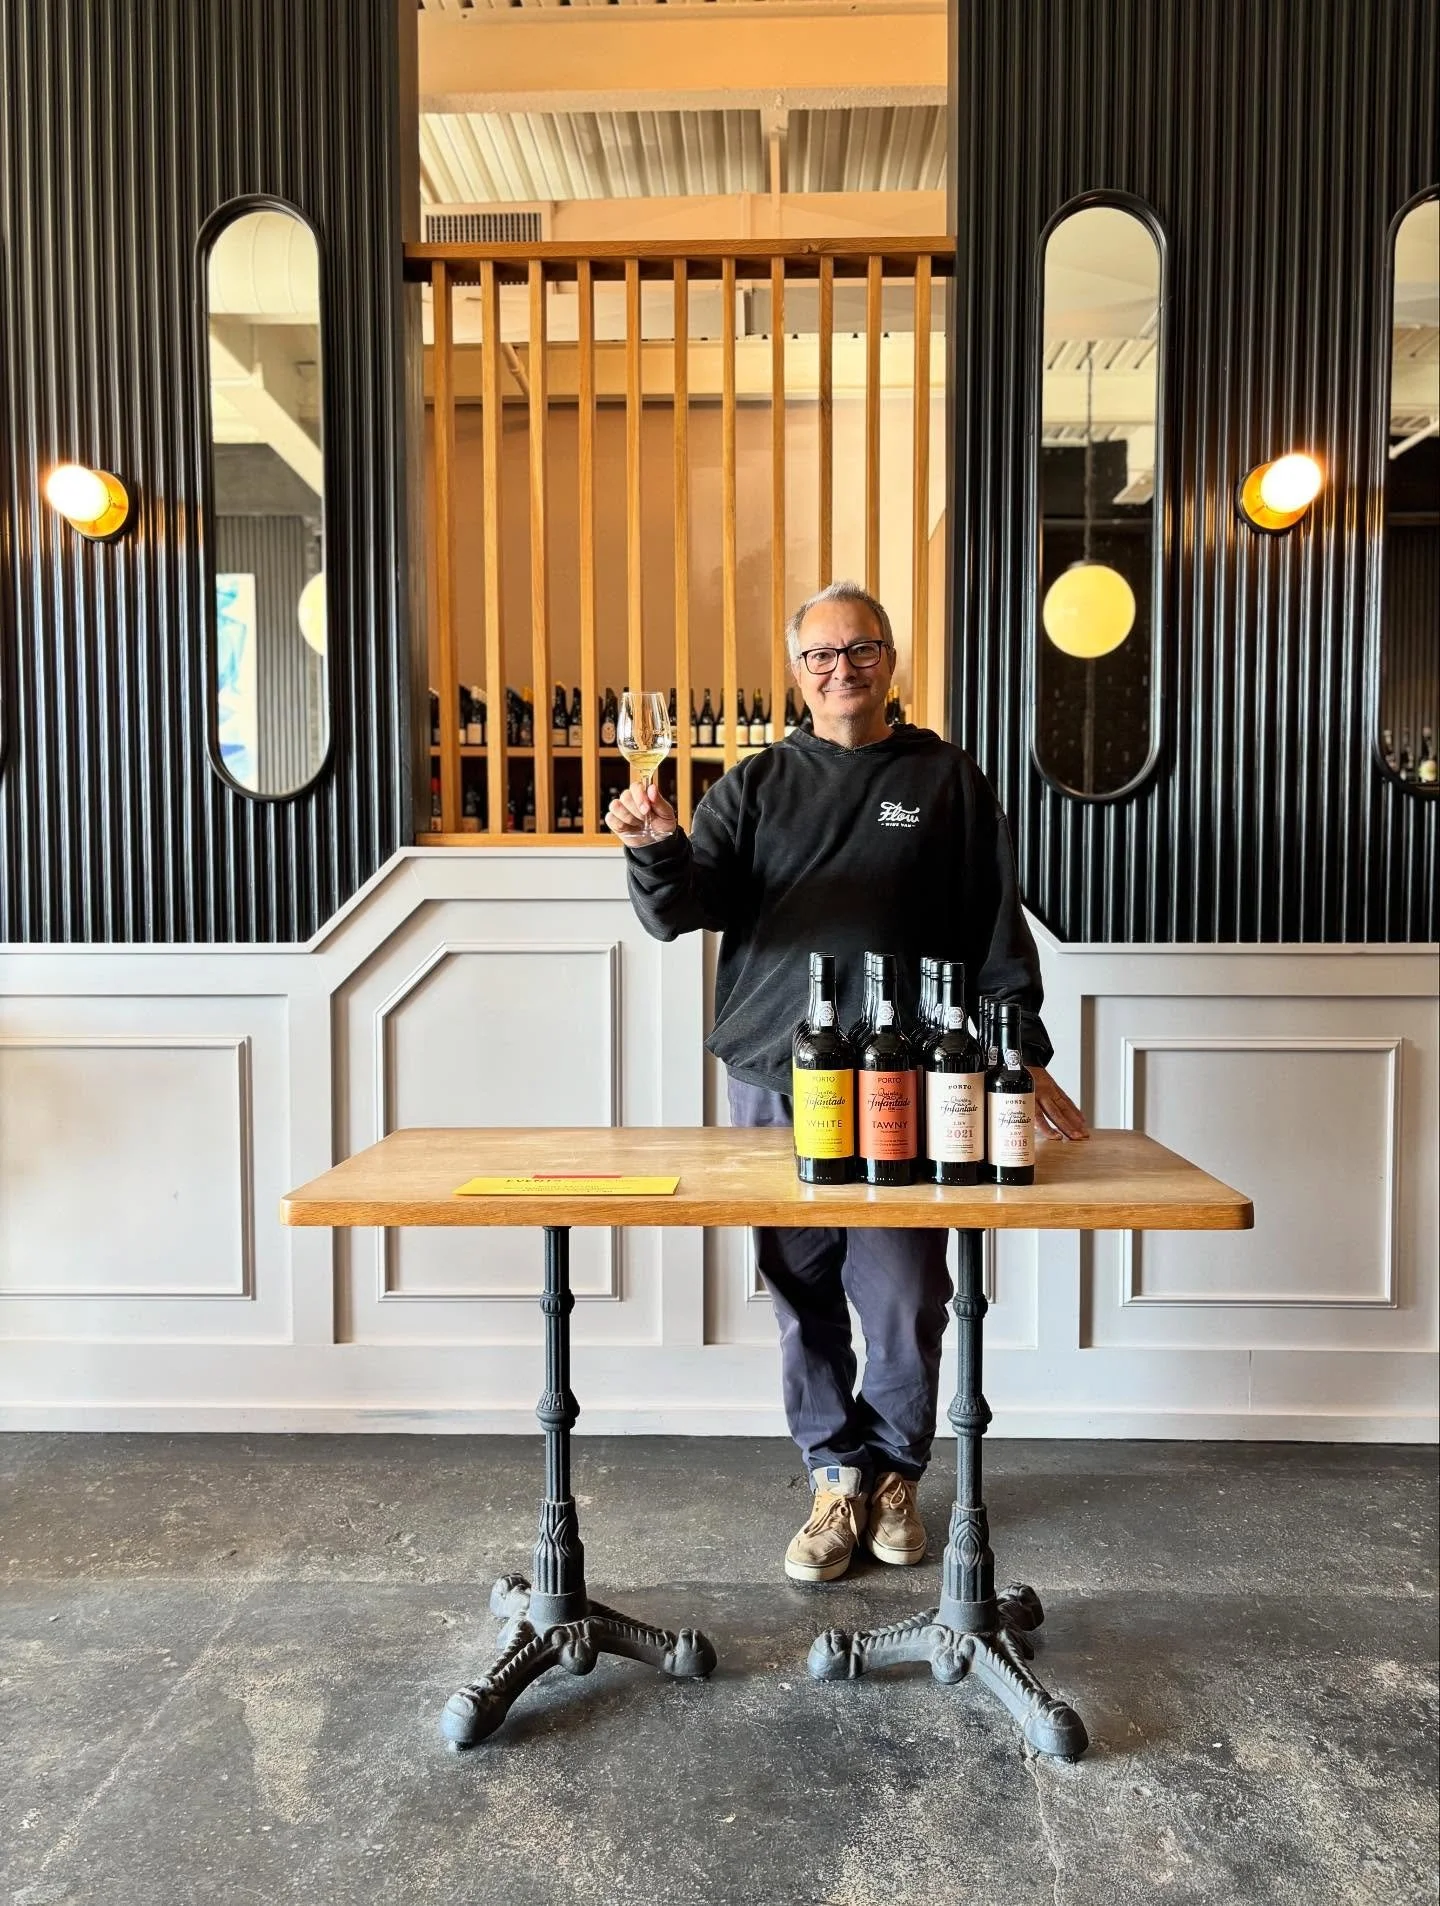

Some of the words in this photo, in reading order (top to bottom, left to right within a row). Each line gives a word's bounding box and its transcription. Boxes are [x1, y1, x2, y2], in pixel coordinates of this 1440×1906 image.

[877, 801, 920, 823] Flow
[807, 1119, 843, 1128] WHITE
[872, 1120, 908, 1129] TAWNY
[946, 1129, 974, 1139] 2021
[1004, 1138, 1028, 1147] 2018
